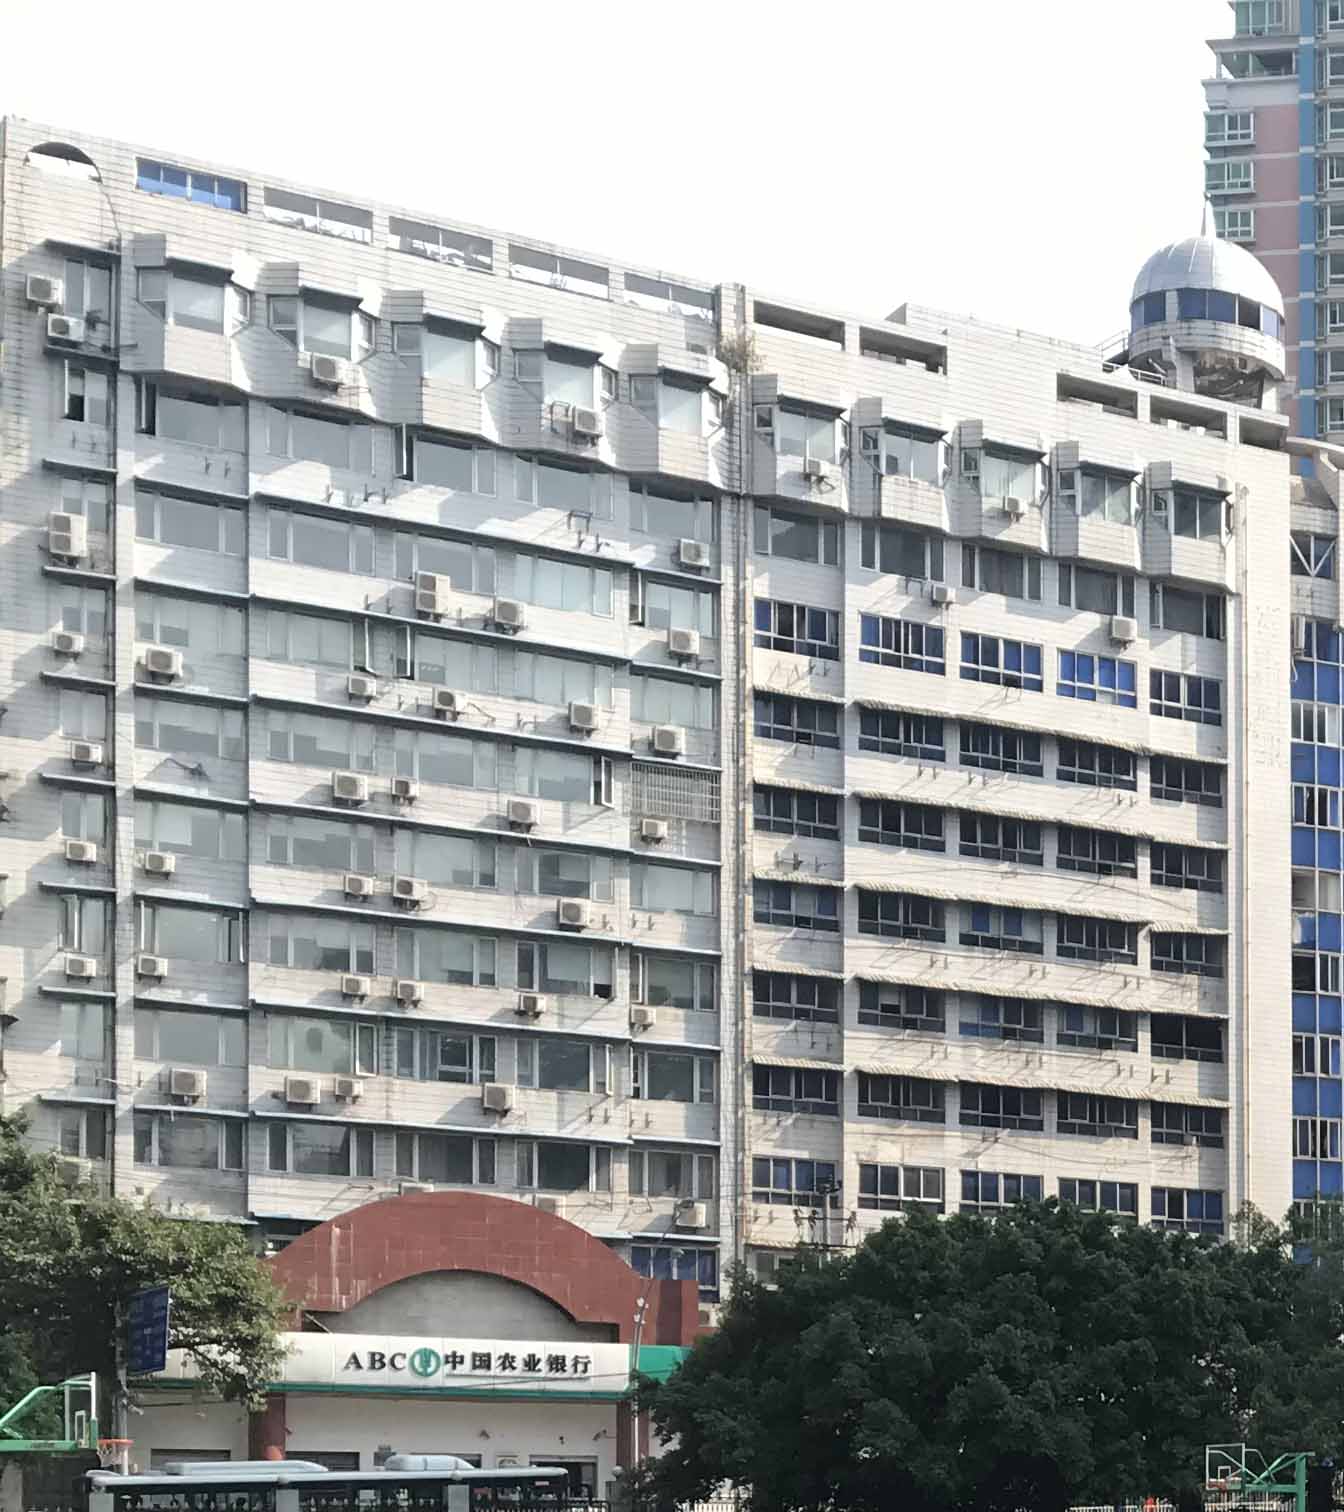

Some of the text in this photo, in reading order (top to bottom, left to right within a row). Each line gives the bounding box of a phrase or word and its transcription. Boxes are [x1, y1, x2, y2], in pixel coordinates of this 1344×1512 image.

[344, 1350, 592, 1374] ABC 中国农业银行
